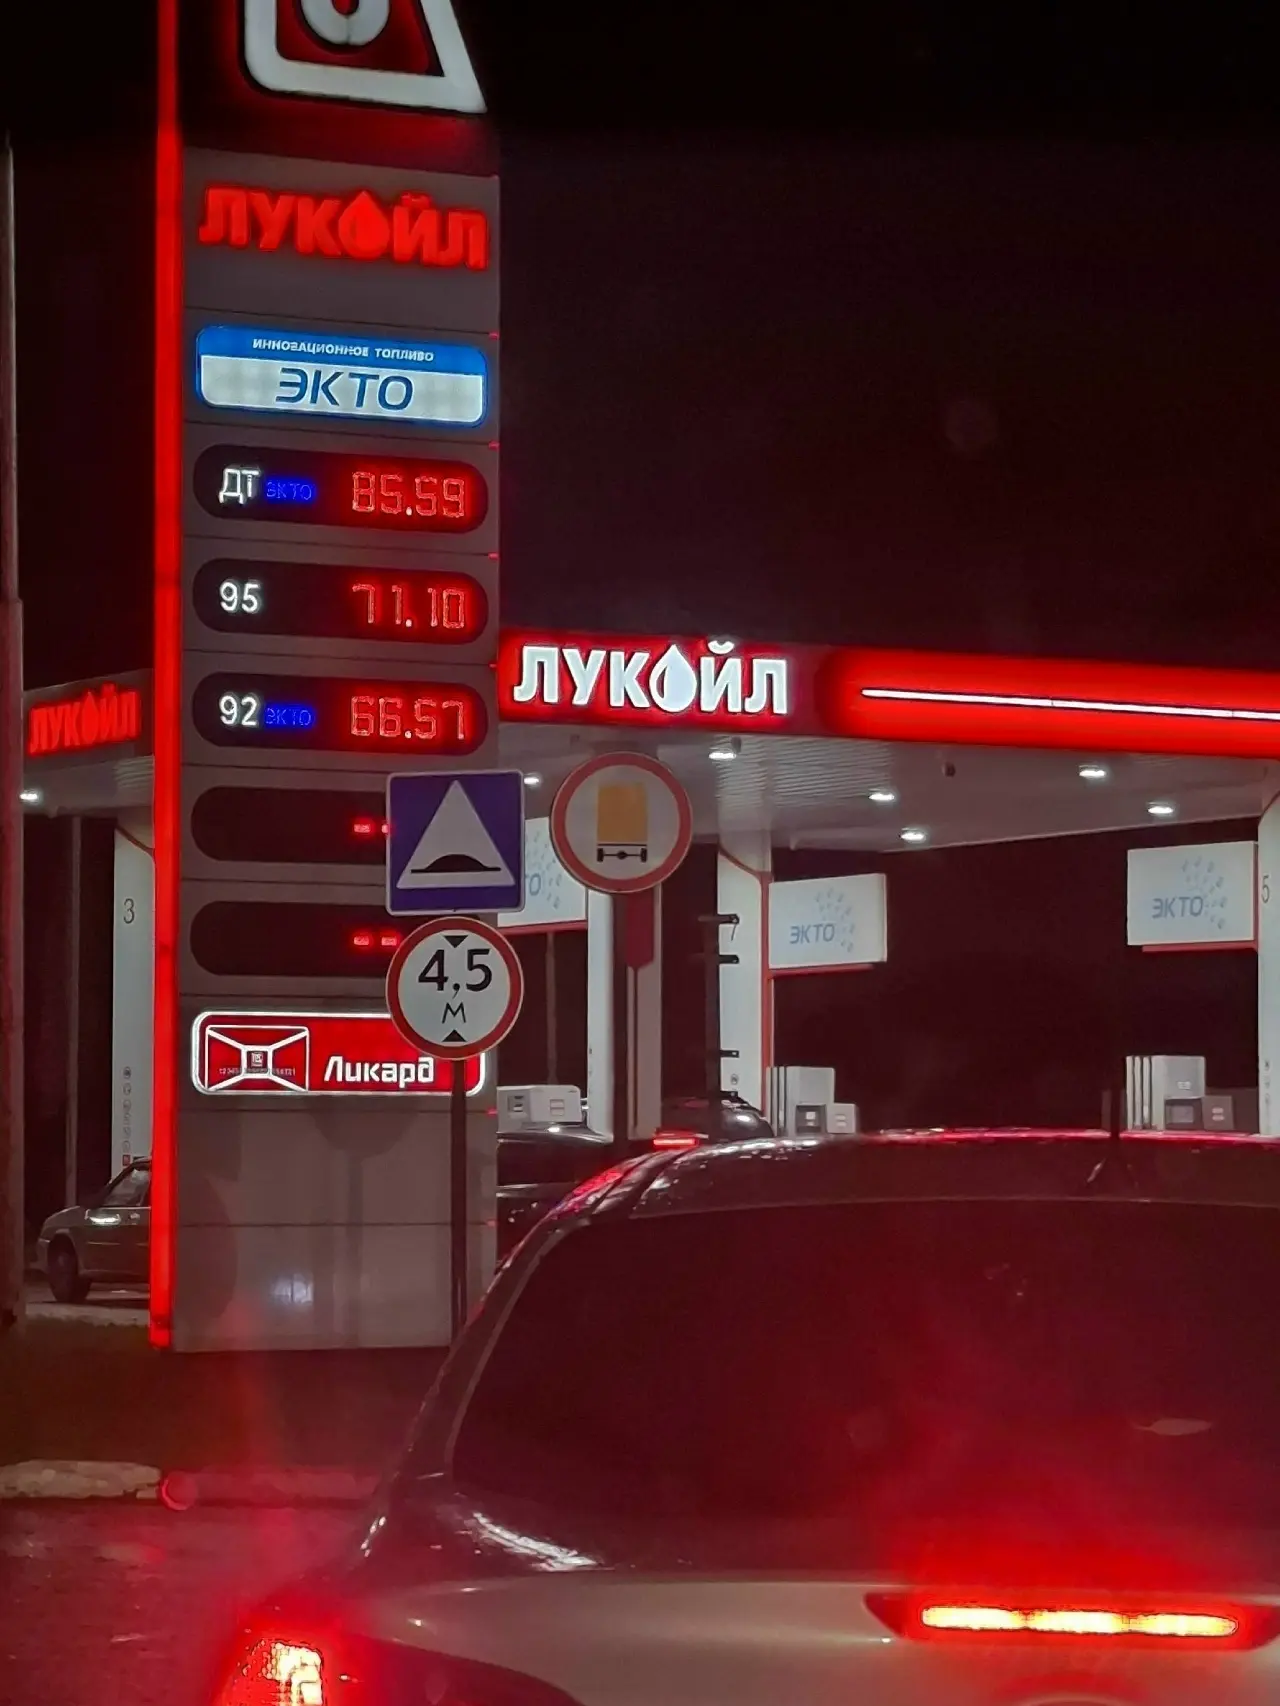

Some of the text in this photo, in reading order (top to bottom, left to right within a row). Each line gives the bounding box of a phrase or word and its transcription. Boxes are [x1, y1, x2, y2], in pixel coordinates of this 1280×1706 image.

[198, 187, 487, 269] ЛУКОЙЛ
[375, 348, 434, 362] ТОПЛИВО
[275, 366, 414, 411] ЭКТО
[219, 465, 466, 518] ДТ ЭКТО 85.59
[219, 581, 466, 629] 95 71.10
[513, 639, 789, 715] ЛУКОЙЛ
[29, 682, 139, 756] ЛУКОЙЛ
[218, 695, 259, 727] 92
[350, 695, 467, 741] 66.57
[122, 898, 136, 925] 3
[1151, 895, 1204, 920] ЭКТО
[789, 922, 836, 946] ЭКТО
[417, 948, 494, 999] 4,5
[324, 1055, 436, 1089] Ликард
